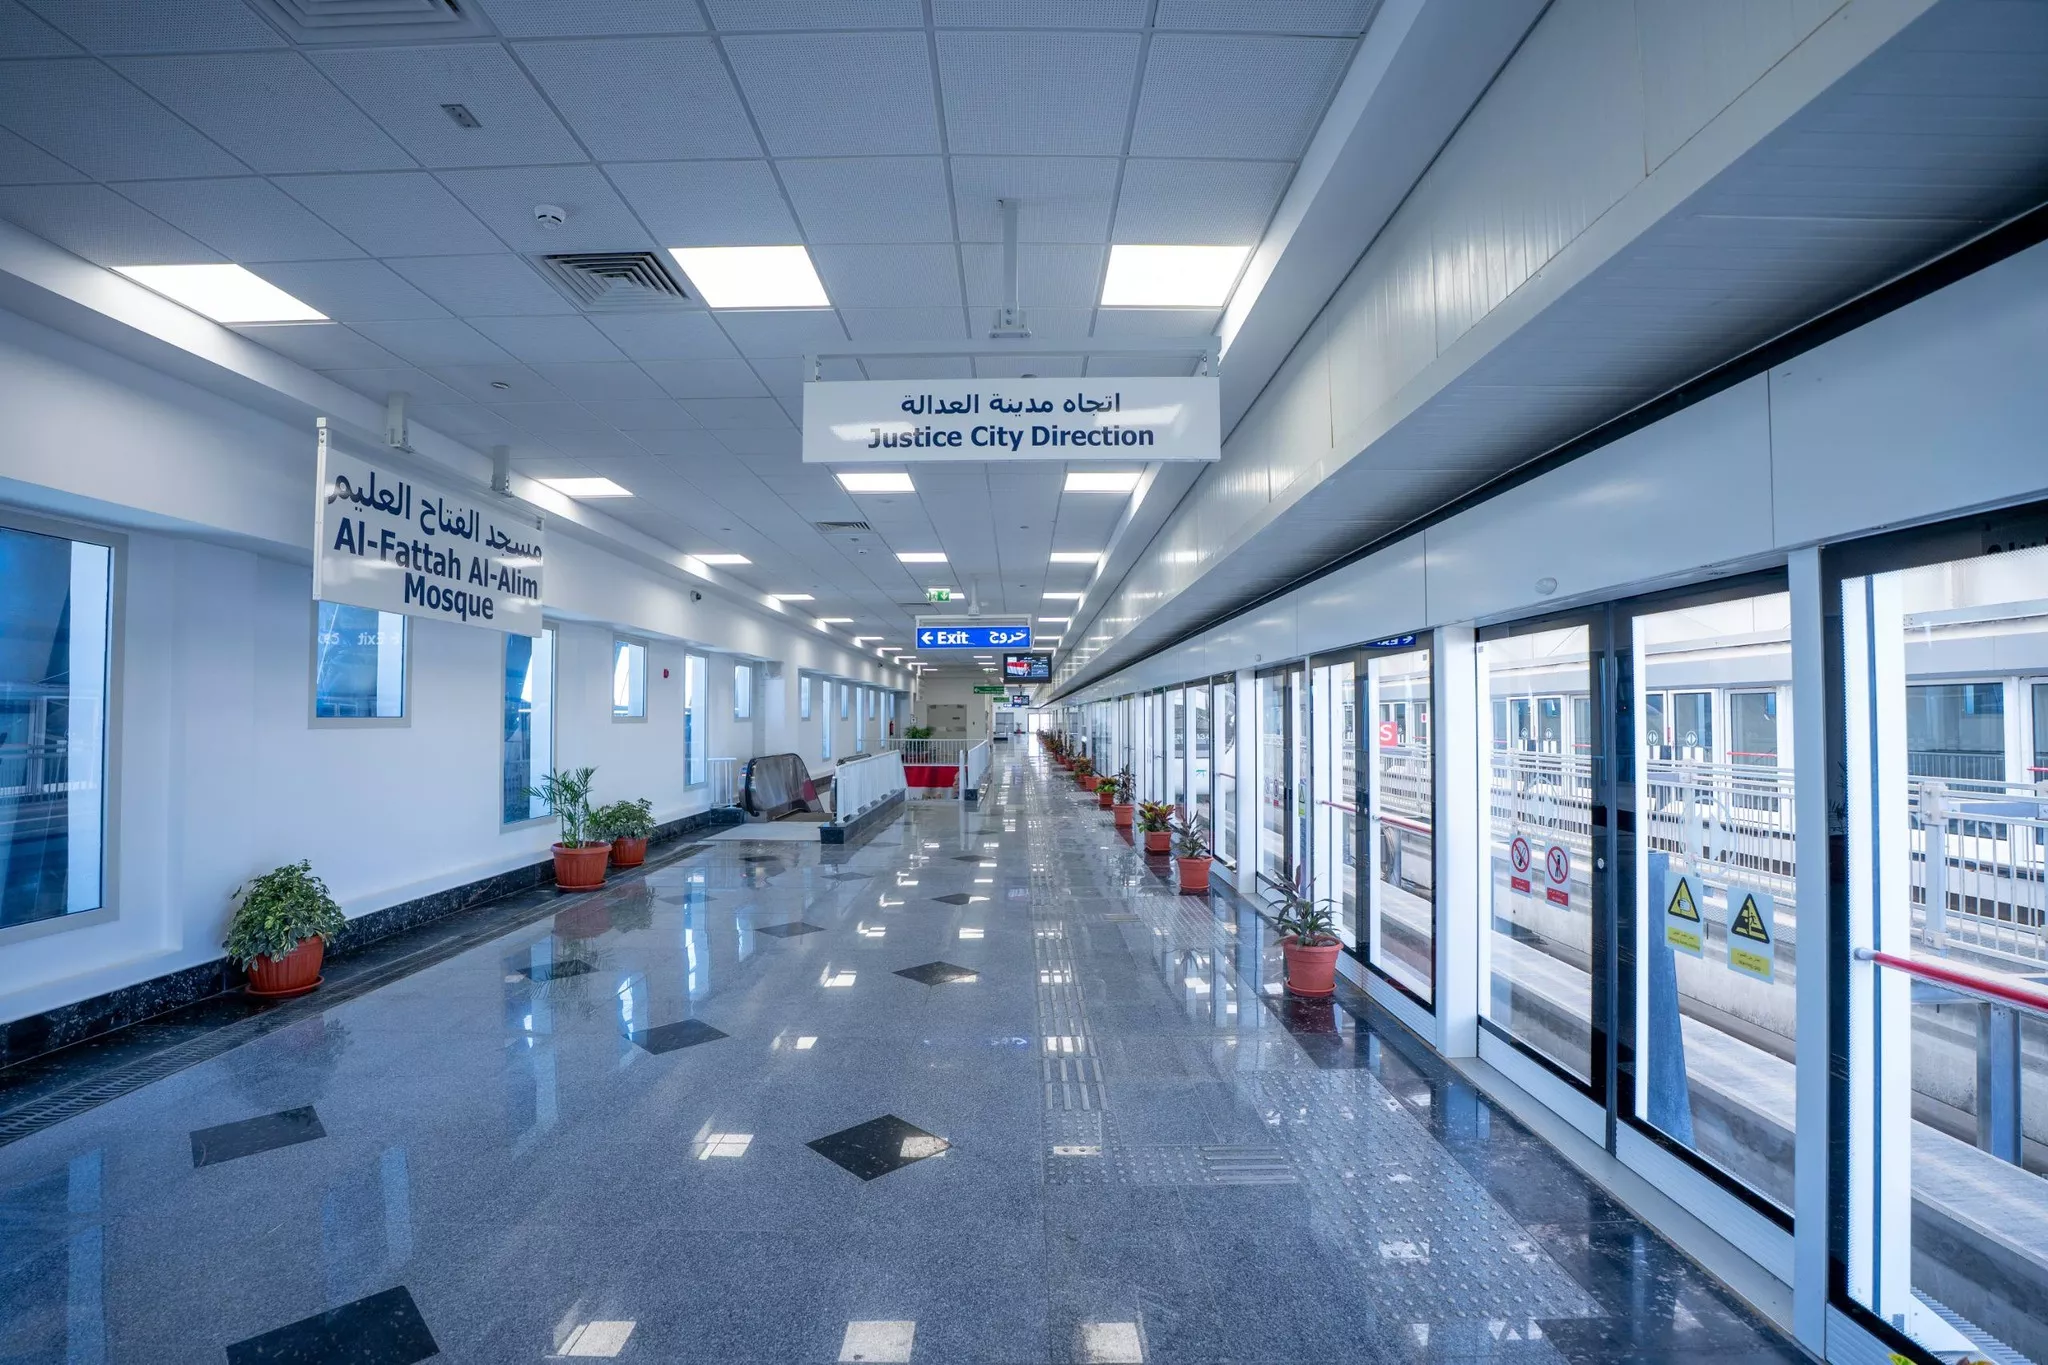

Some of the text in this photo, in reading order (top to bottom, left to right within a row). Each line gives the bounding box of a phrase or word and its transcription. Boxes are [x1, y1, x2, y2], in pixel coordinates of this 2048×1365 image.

[900, 392, 1120, 418] اتجاه مدينة العدالة
[867, 424, 1154, 452] Justice City Direction
[327, 471, 542, 561] مسجد الفتاح العليم
[333, 517, 538, 600] Al-Fattah Al-Alim
[404, 571, 494, 623] Mosque
[937, 631, 970, 645] Exit
[989, 630, 1027, 644] خروج
[1380, 724, 1393, 742] S
